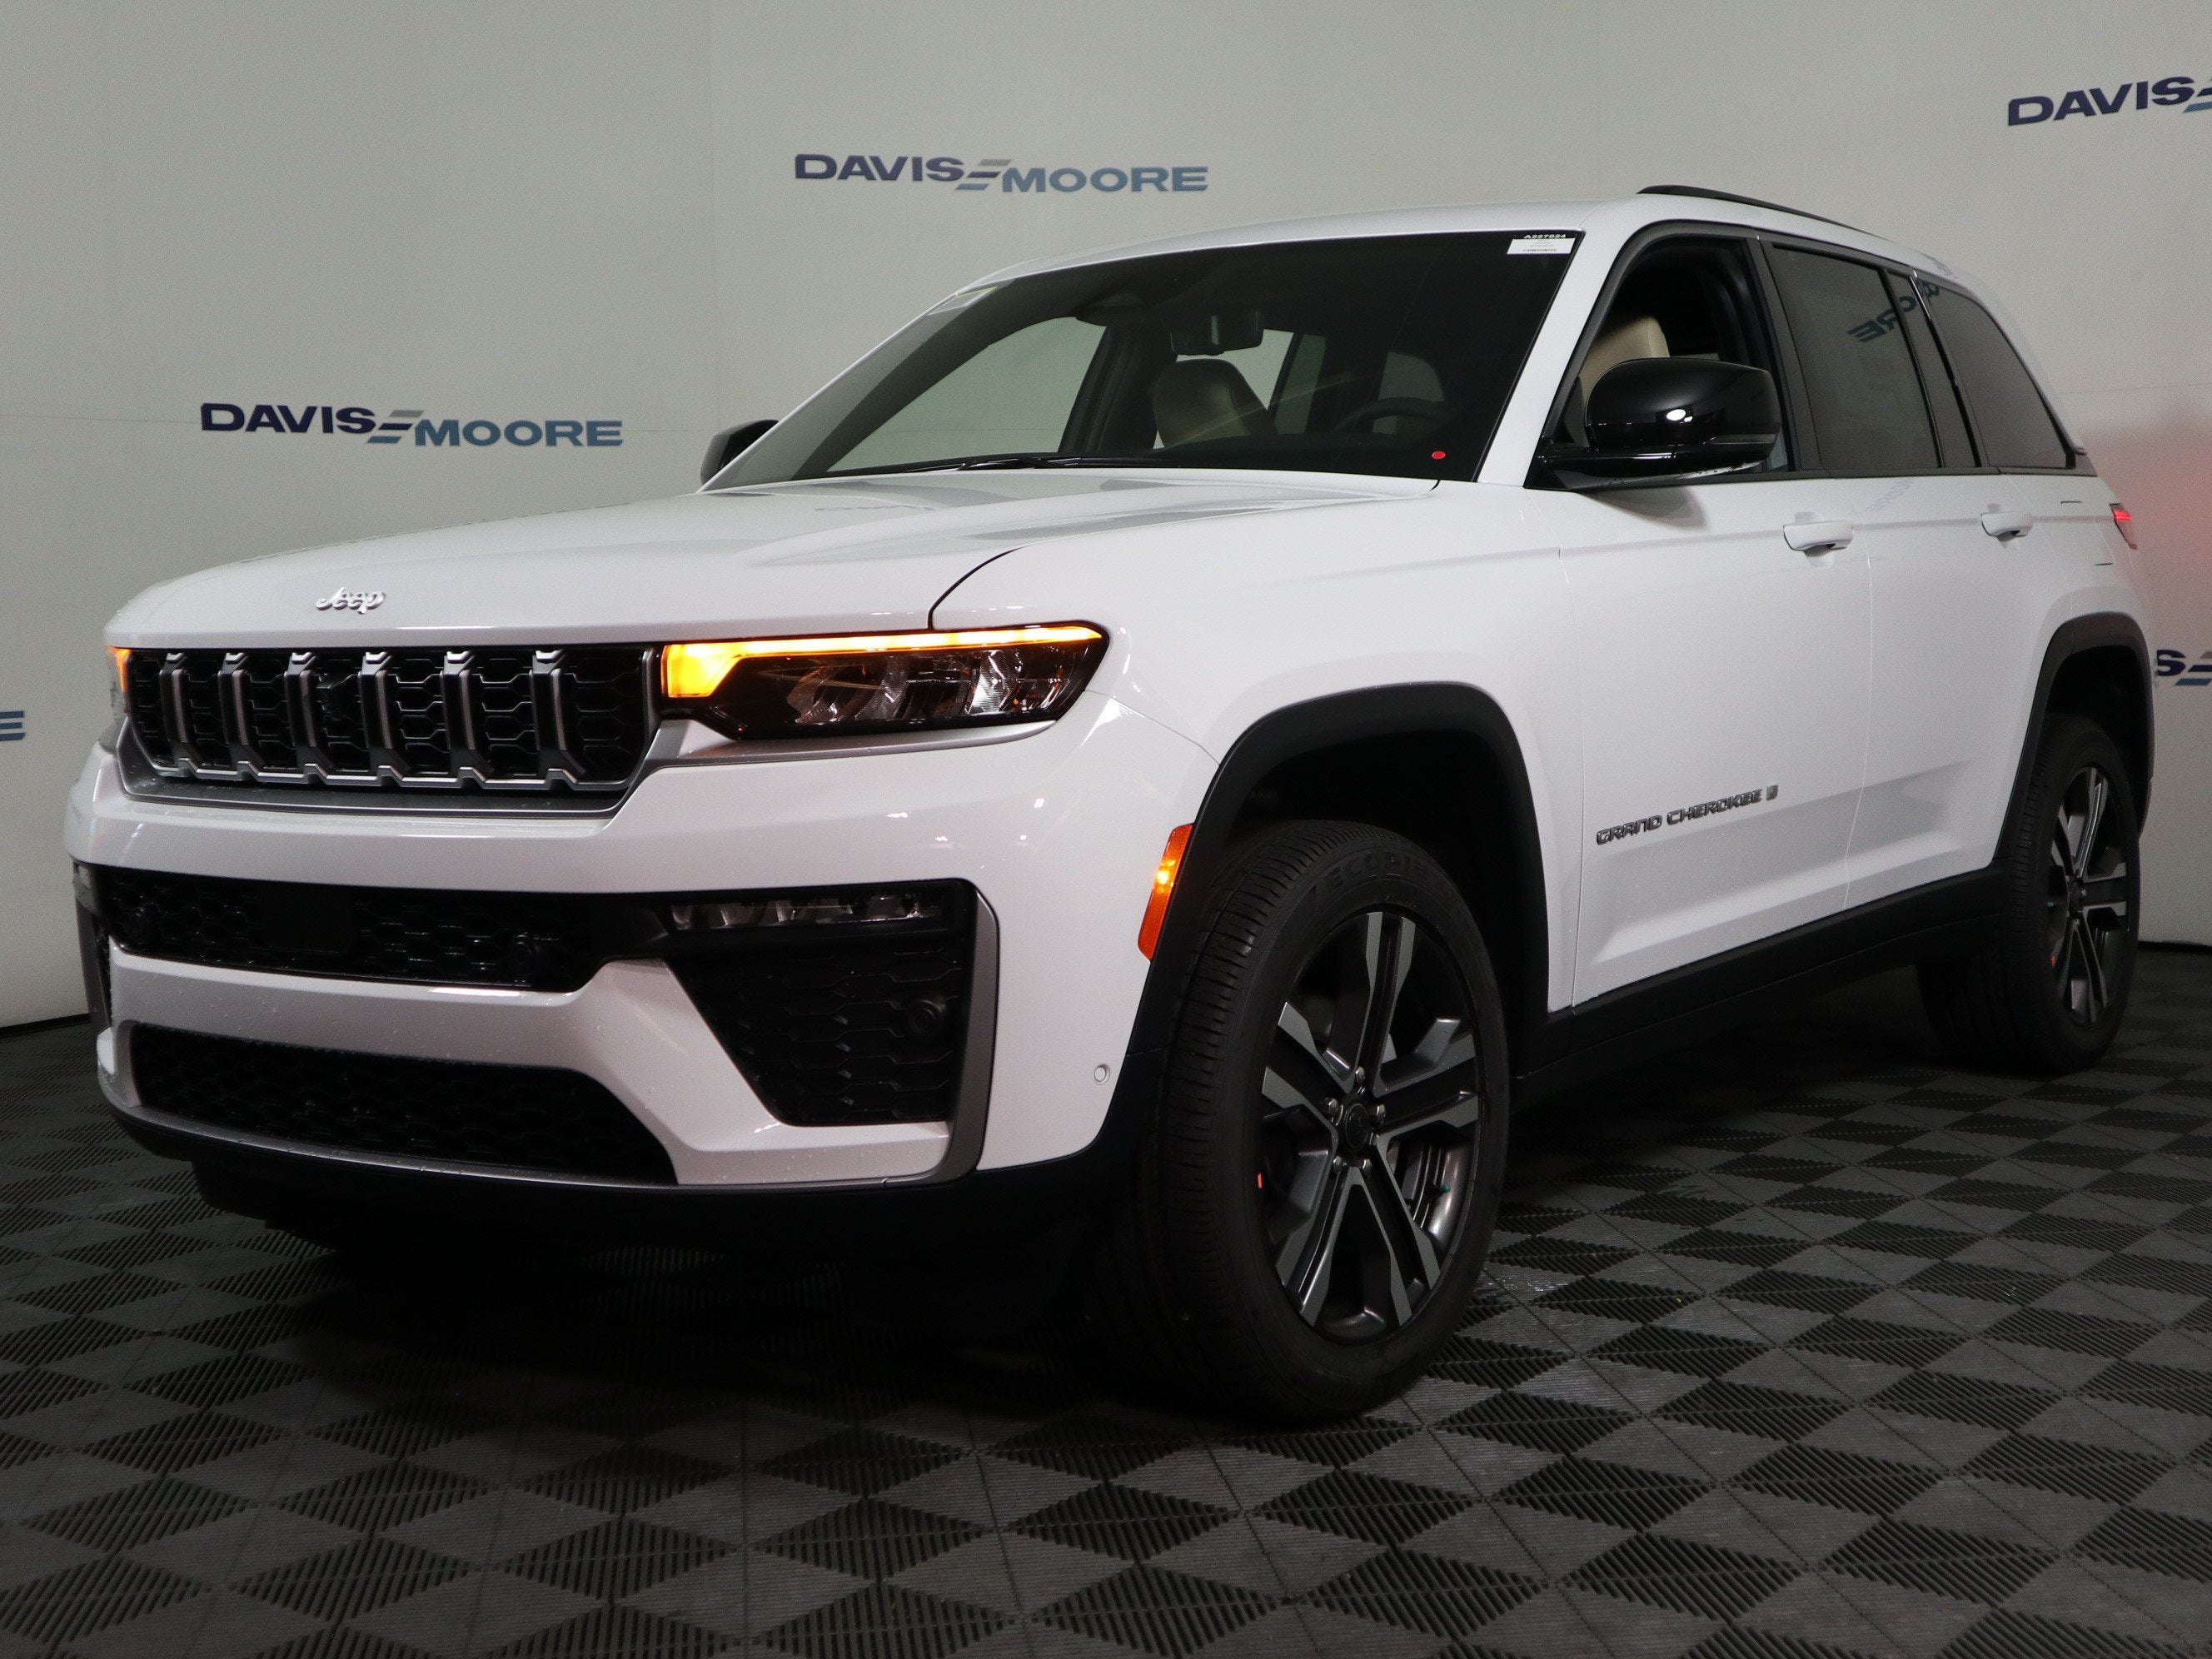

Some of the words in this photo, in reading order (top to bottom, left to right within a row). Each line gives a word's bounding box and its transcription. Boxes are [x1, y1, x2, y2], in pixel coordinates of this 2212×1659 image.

[2007, 76, 2195, 126] DAVIS
[794, 153, 964, 182] DAVIS
[1002, 166, 1208, 193] MOORE
[200, 402, 376, 435] DAVIS
[414, 419, 624, 447] MOORE
[316, 586, 386, 615] Jeep
[1596, 814, 1663, 845] GRAND
[1666, 789, 1763, 825] CHEROKEE
